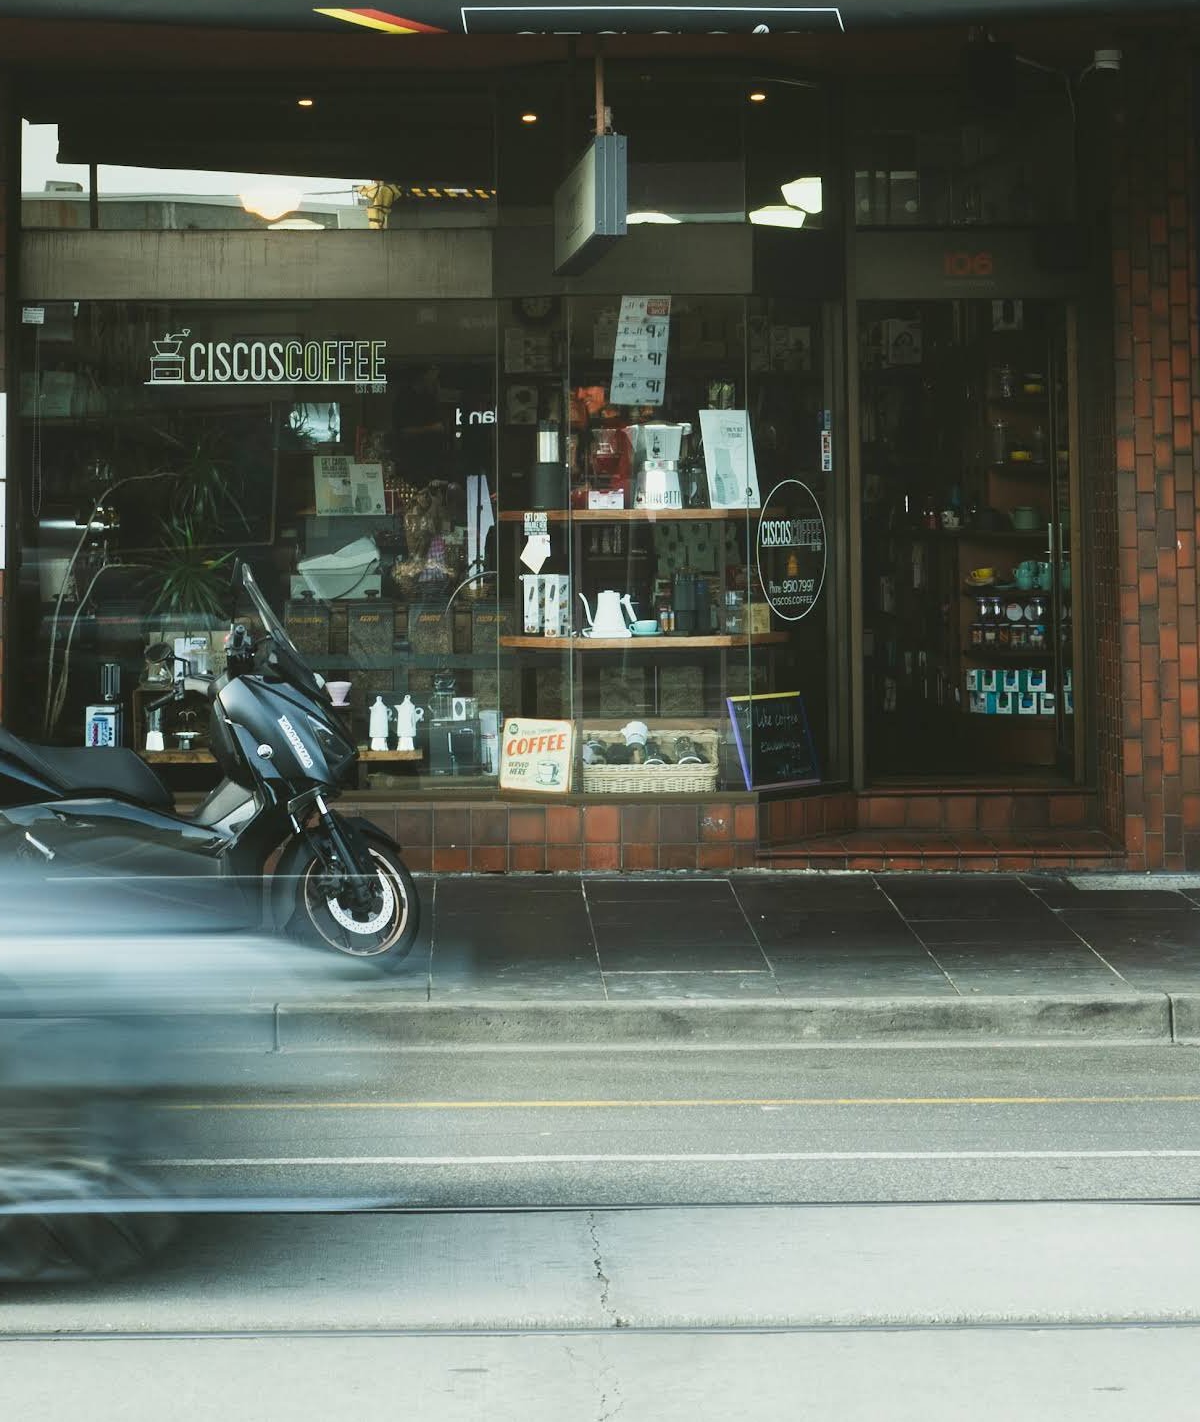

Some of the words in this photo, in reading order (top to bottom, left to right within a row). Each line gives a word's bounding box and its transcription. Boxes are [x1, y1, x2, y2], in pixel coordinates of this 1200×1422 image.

[943, 250, 995, 275] 106
[761, 520, 792, 546] CISCOS
[791, 518, 823, 545] COFFEE
[277, 714, 314, 769] YAMAHA
[506, 733, 567, 756] COFFEE
[509, 767, 528, 776] HERE
